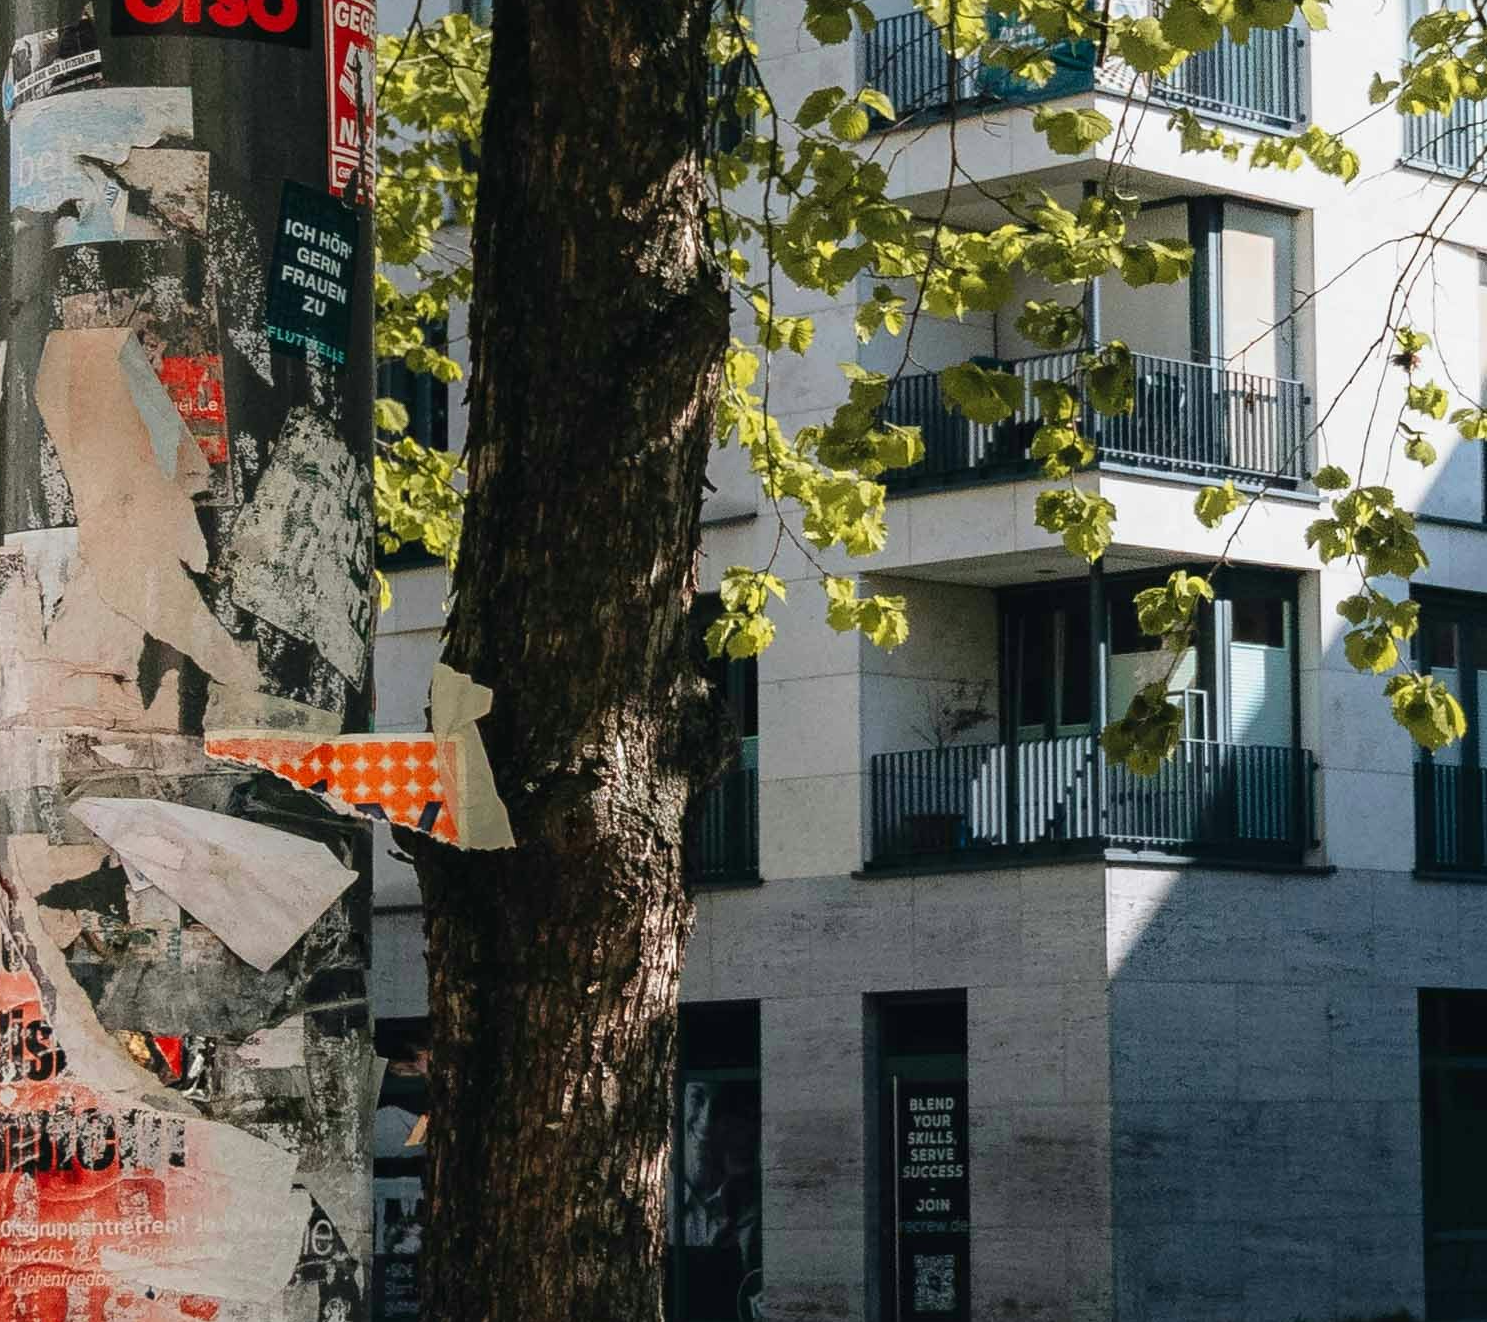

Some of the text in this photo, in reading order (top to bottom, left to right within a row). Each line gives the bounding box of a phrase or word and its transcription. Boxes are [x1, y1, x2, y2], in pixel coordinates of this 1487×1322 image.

[284, 218, 316, 245] ICH
[296, 246, 342, 279] GERN
[280, 264, 347, 305] FRAUEN
[301, 295, 327, 317] ZU
[909, 1097, 954, 1111] BLEND
[913, 1114, 951, 1127] YOUR
[910, 1148, 954, 1162] SERVE
[902, 1164, 963, 1178] SUCCESS
[915, 1198, 950, 1212] JOIN
